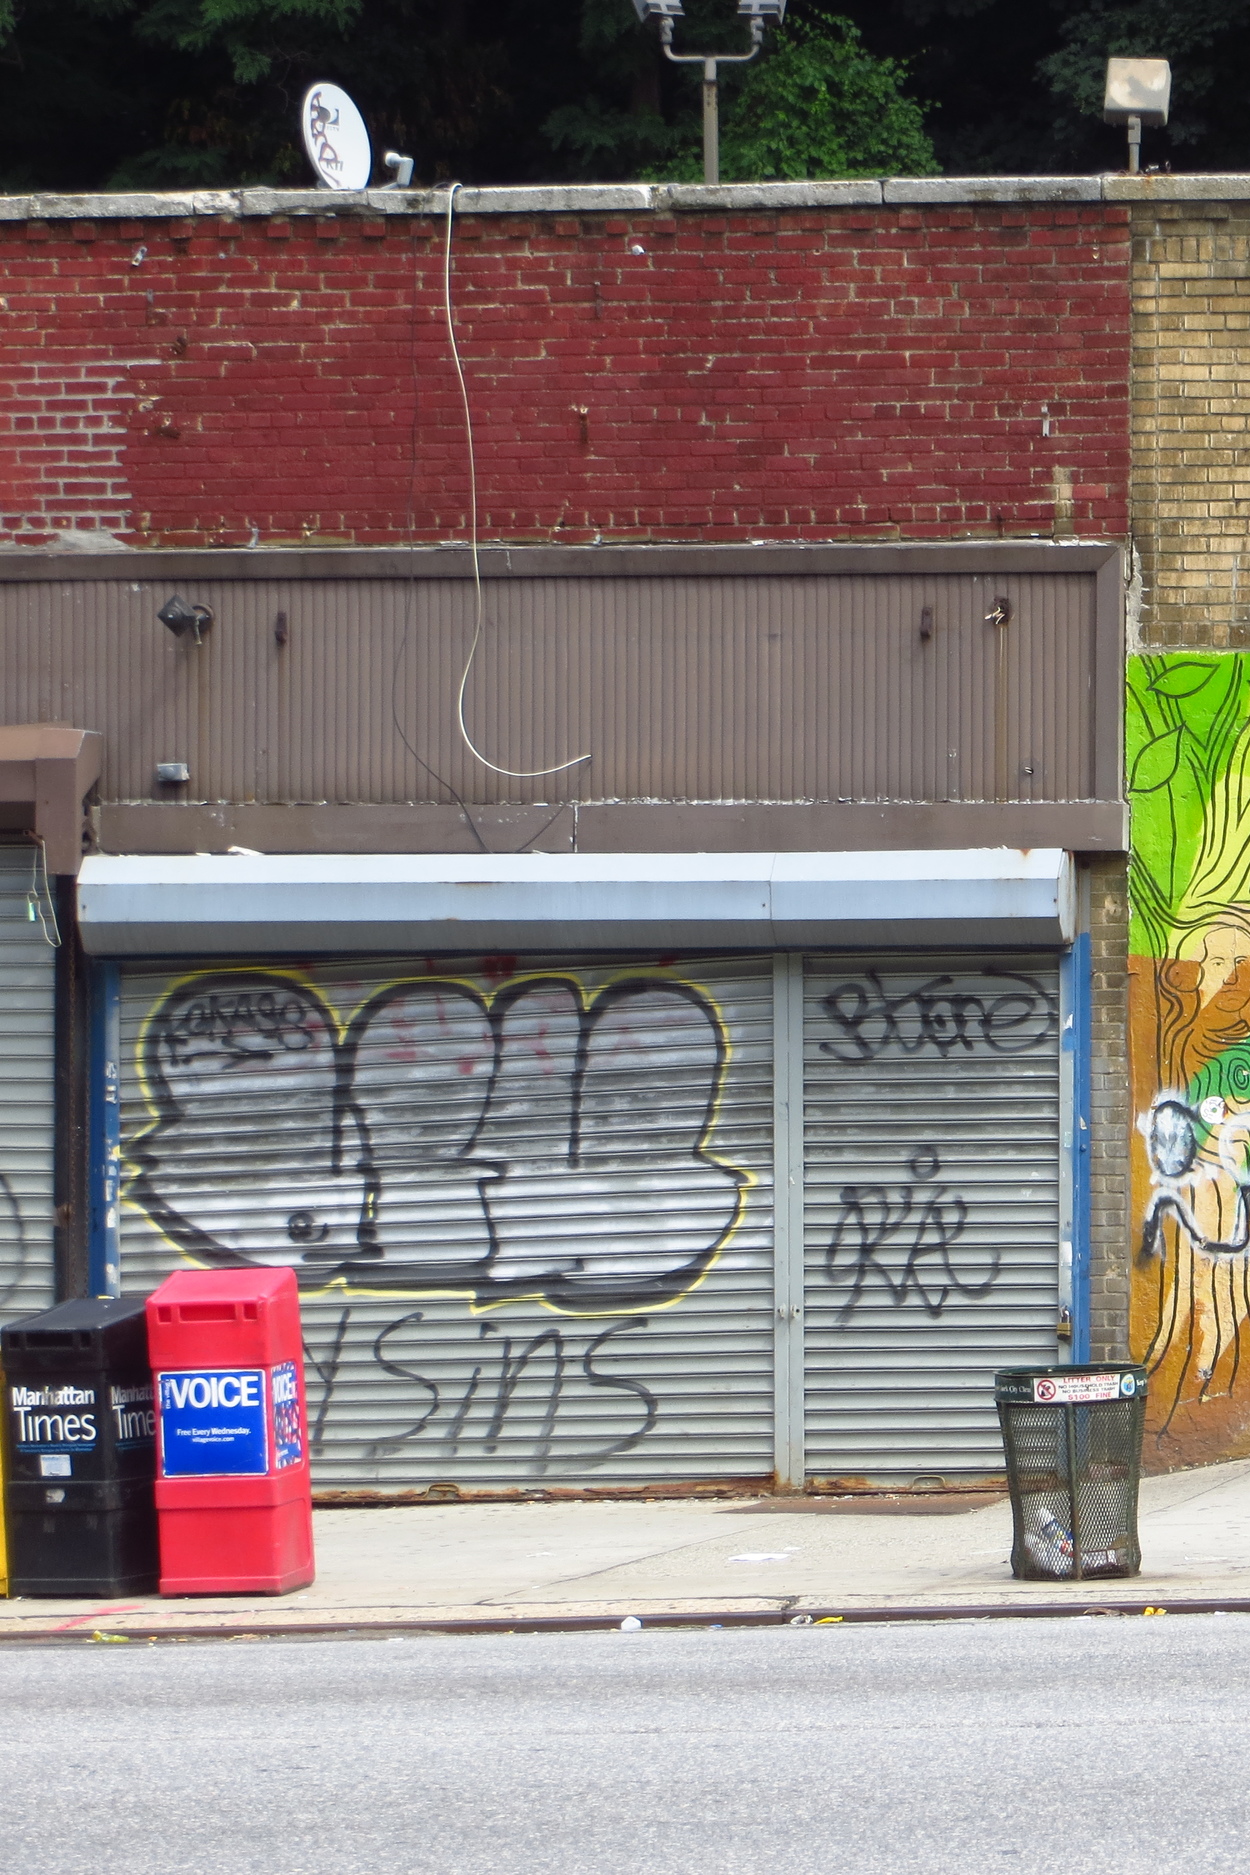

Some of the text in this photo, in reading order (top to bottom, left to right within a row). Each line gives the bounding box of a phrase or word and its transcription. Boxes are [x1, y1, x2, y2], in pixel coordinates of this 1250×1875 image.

[1063, 1374, 1116, 1384] LITTER ONLY
[12, 1385, 95, 1407] Manhattan
[170, 1376, 260, 1409] VOICE
[1068, 1391, 1112, 1401] $100 FINE
[13, 1406, 97, 1442] Times
[112, 1404, 156, 1440] Time
[176, 1427, 252, 1437] Free Every Wednesday.
